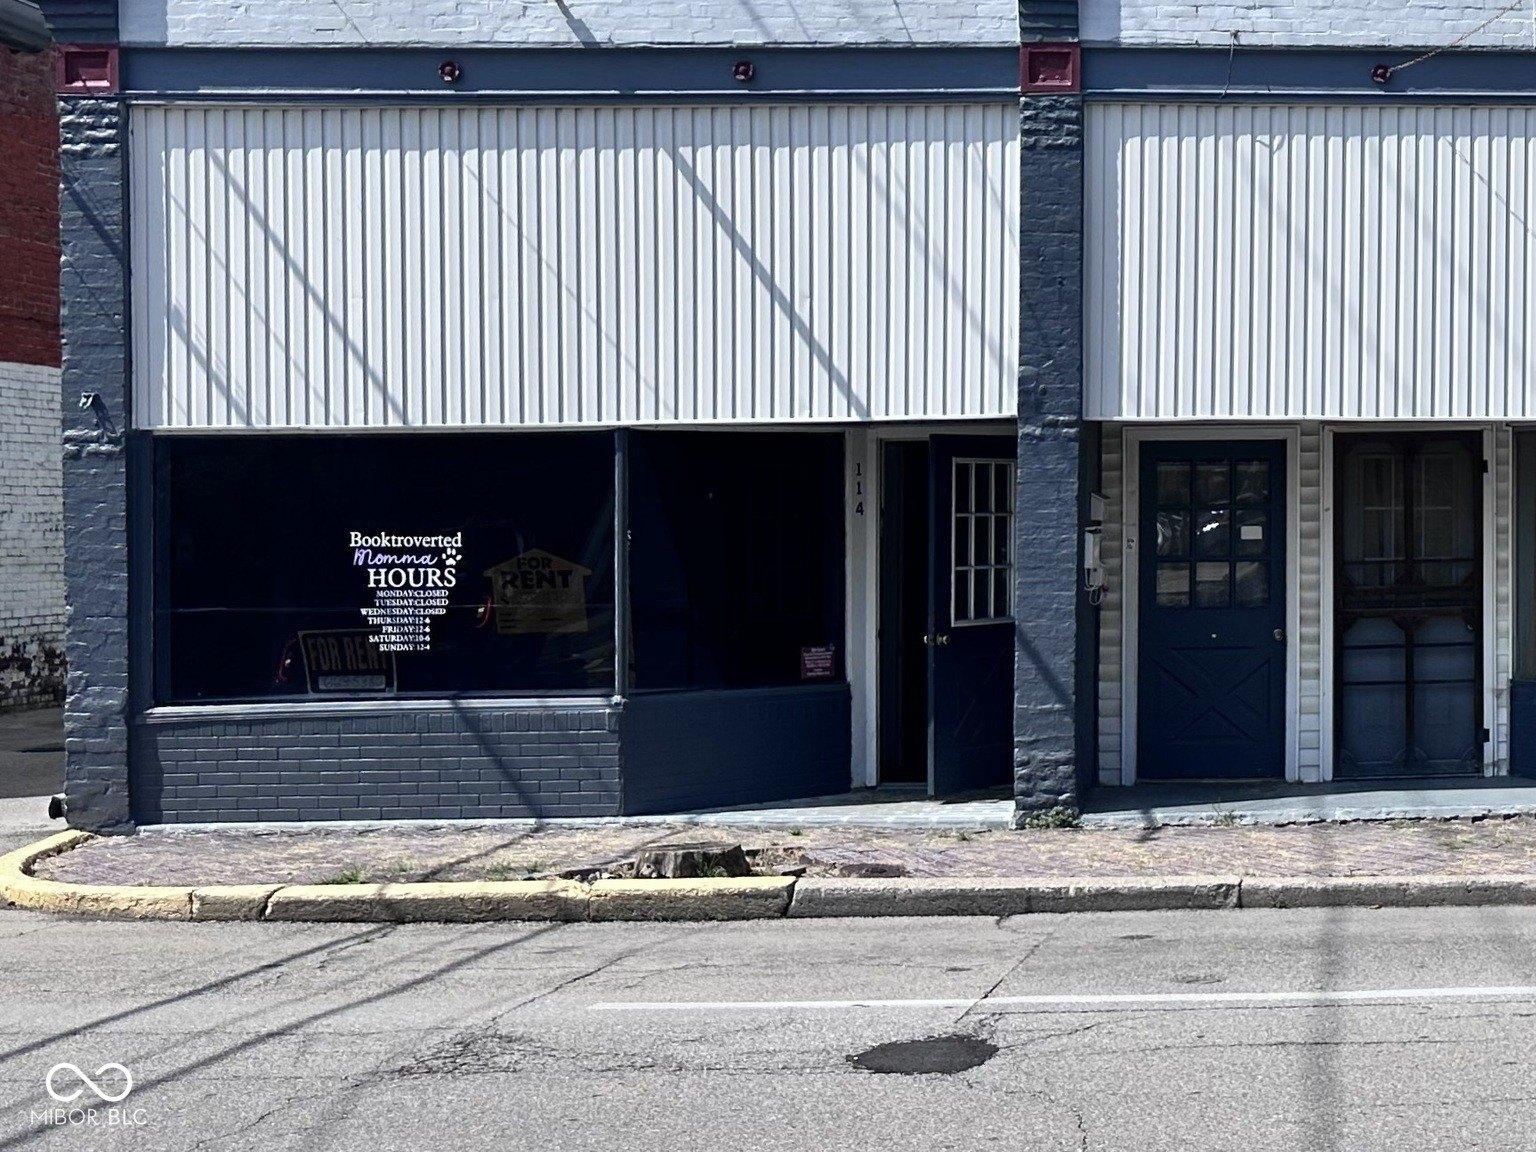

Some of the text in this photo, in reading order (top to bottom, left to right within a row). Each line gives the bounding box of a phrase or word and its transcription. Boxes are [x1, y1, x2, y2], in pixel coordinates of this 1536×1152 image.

[350, 531, 462, 547] Booktroverted
[353, 548, 438, 565] Momma
[367, 567, 456, 588] HOURS
[500, 569, 573, 589] RENT
